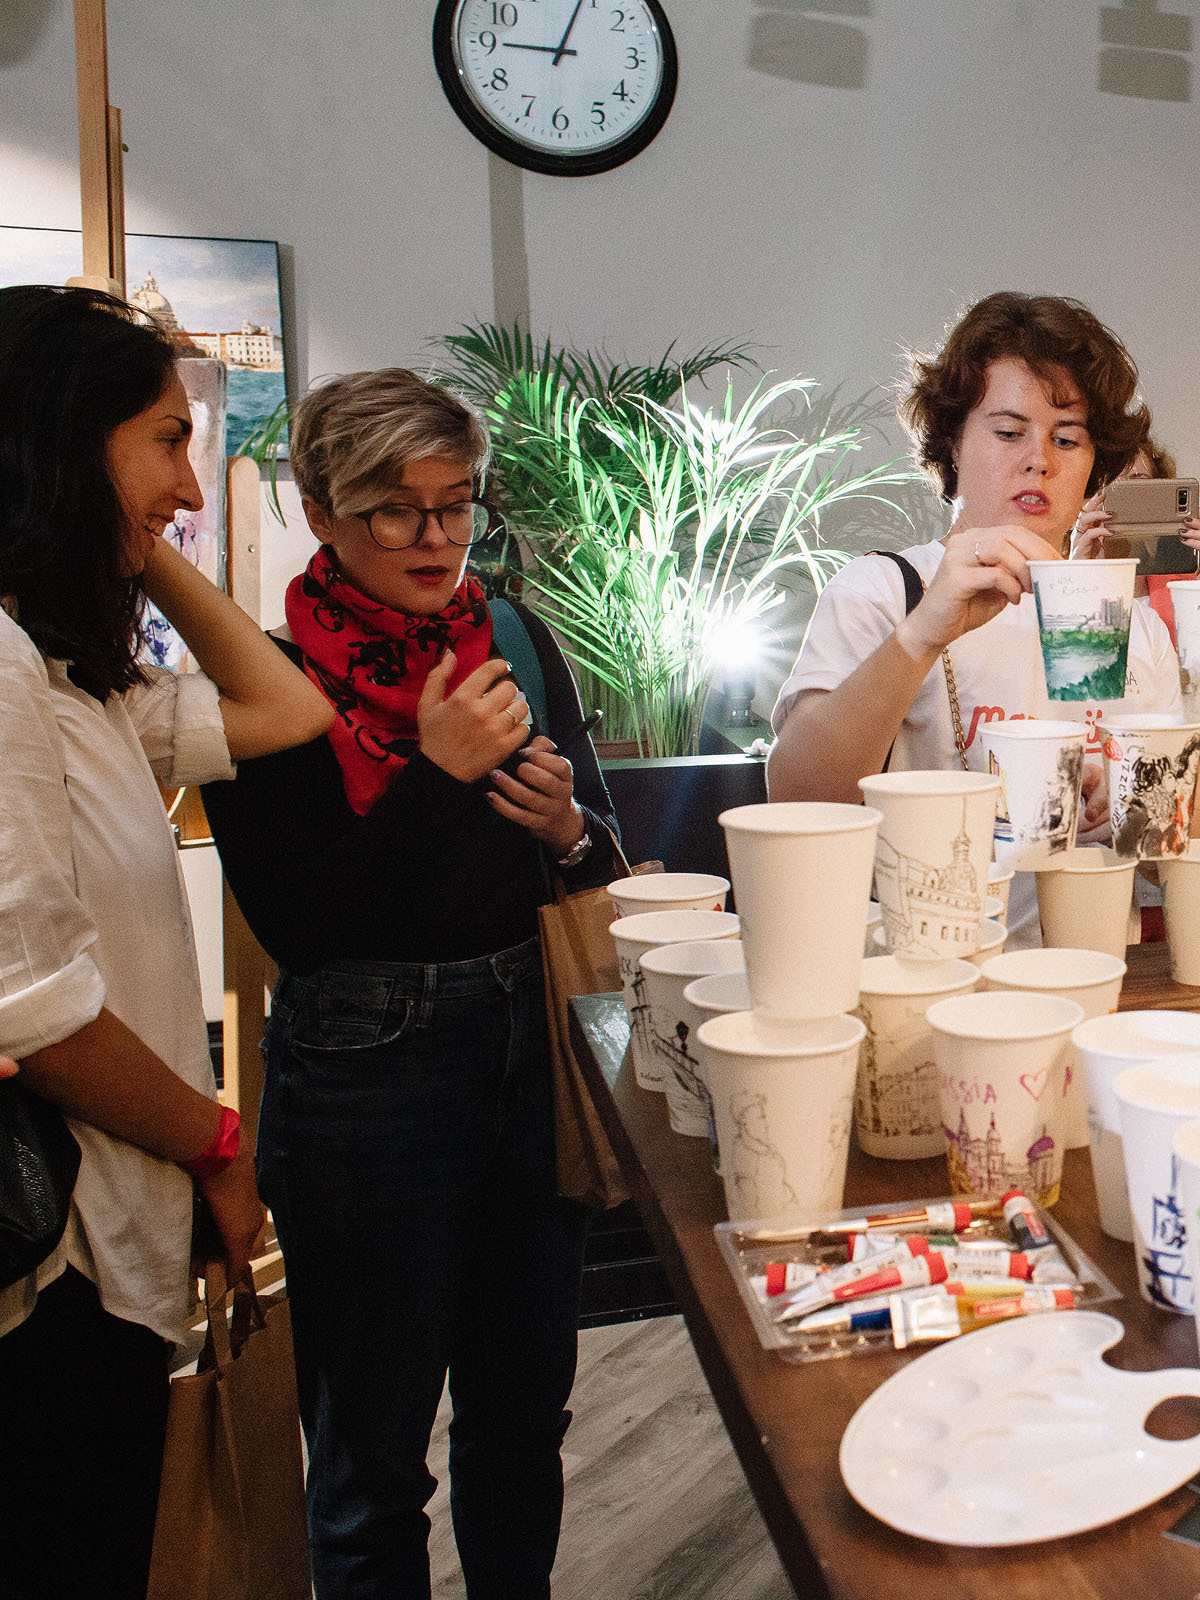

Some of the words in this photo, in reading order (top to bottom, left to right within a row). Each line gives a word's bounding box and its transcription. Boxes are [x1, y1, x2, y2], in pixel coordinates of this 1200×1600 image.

[489, 1, 518, 27] 10
[610, 9, 627, 33] 2
[478, 30, 497, 56] 9
[624, 47, 640, 71] 3
[490, 67, 509, 92] 8
[612, 78, 628, 102] 4
[521, 94, 536, 118] 7
[551, 105, 570, 131] 6
[590, 101, 606, 126] 5
